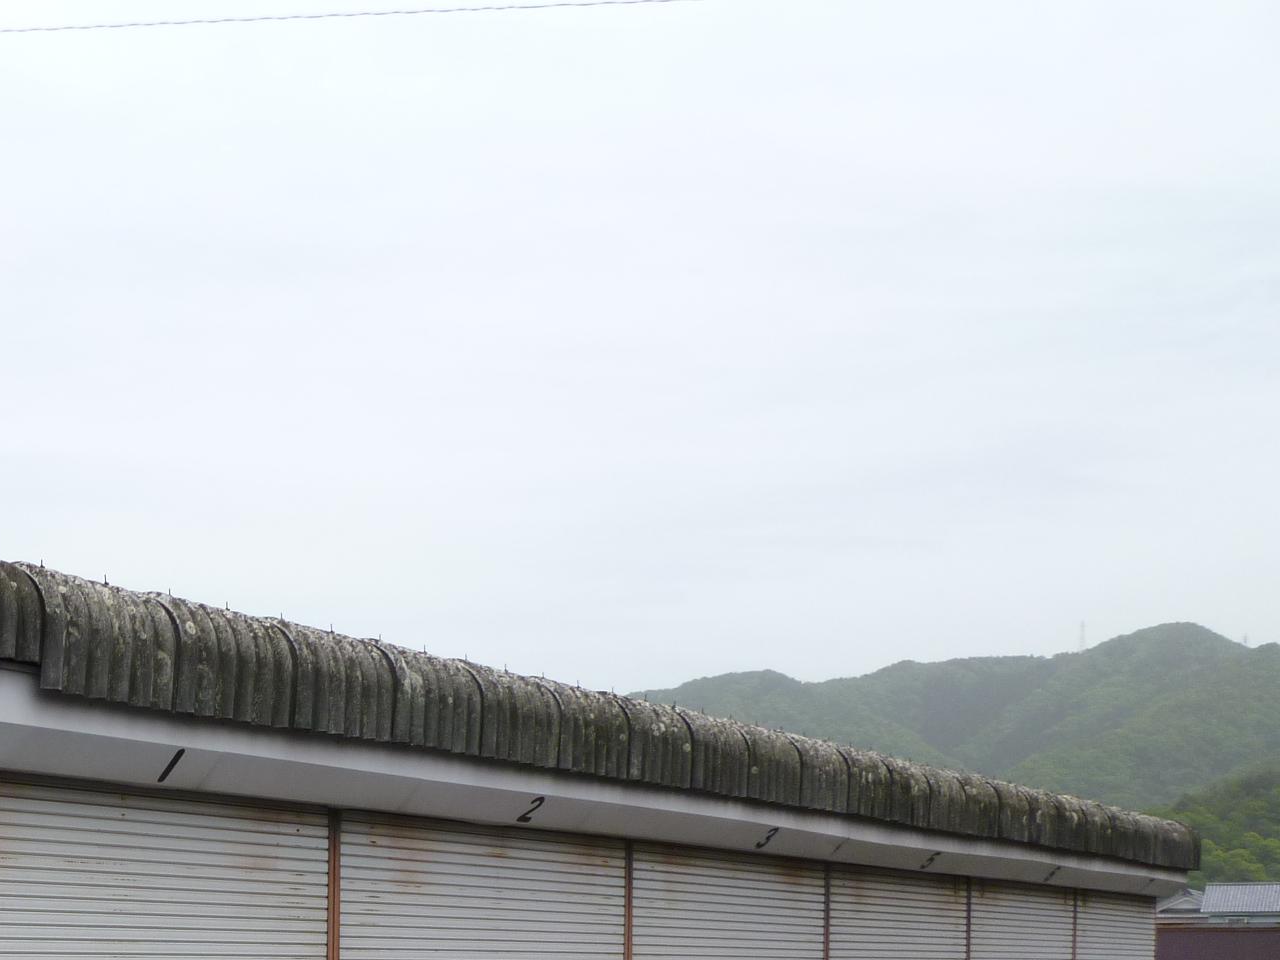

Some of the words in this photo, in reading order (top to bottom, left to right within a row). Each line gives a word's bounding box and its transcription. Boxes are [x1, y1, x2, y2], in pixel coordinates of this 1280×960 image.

[516, 796, 545, 823] 2
[755, 826, 779, 849] 3
[920, 851, 941, 869] 5
